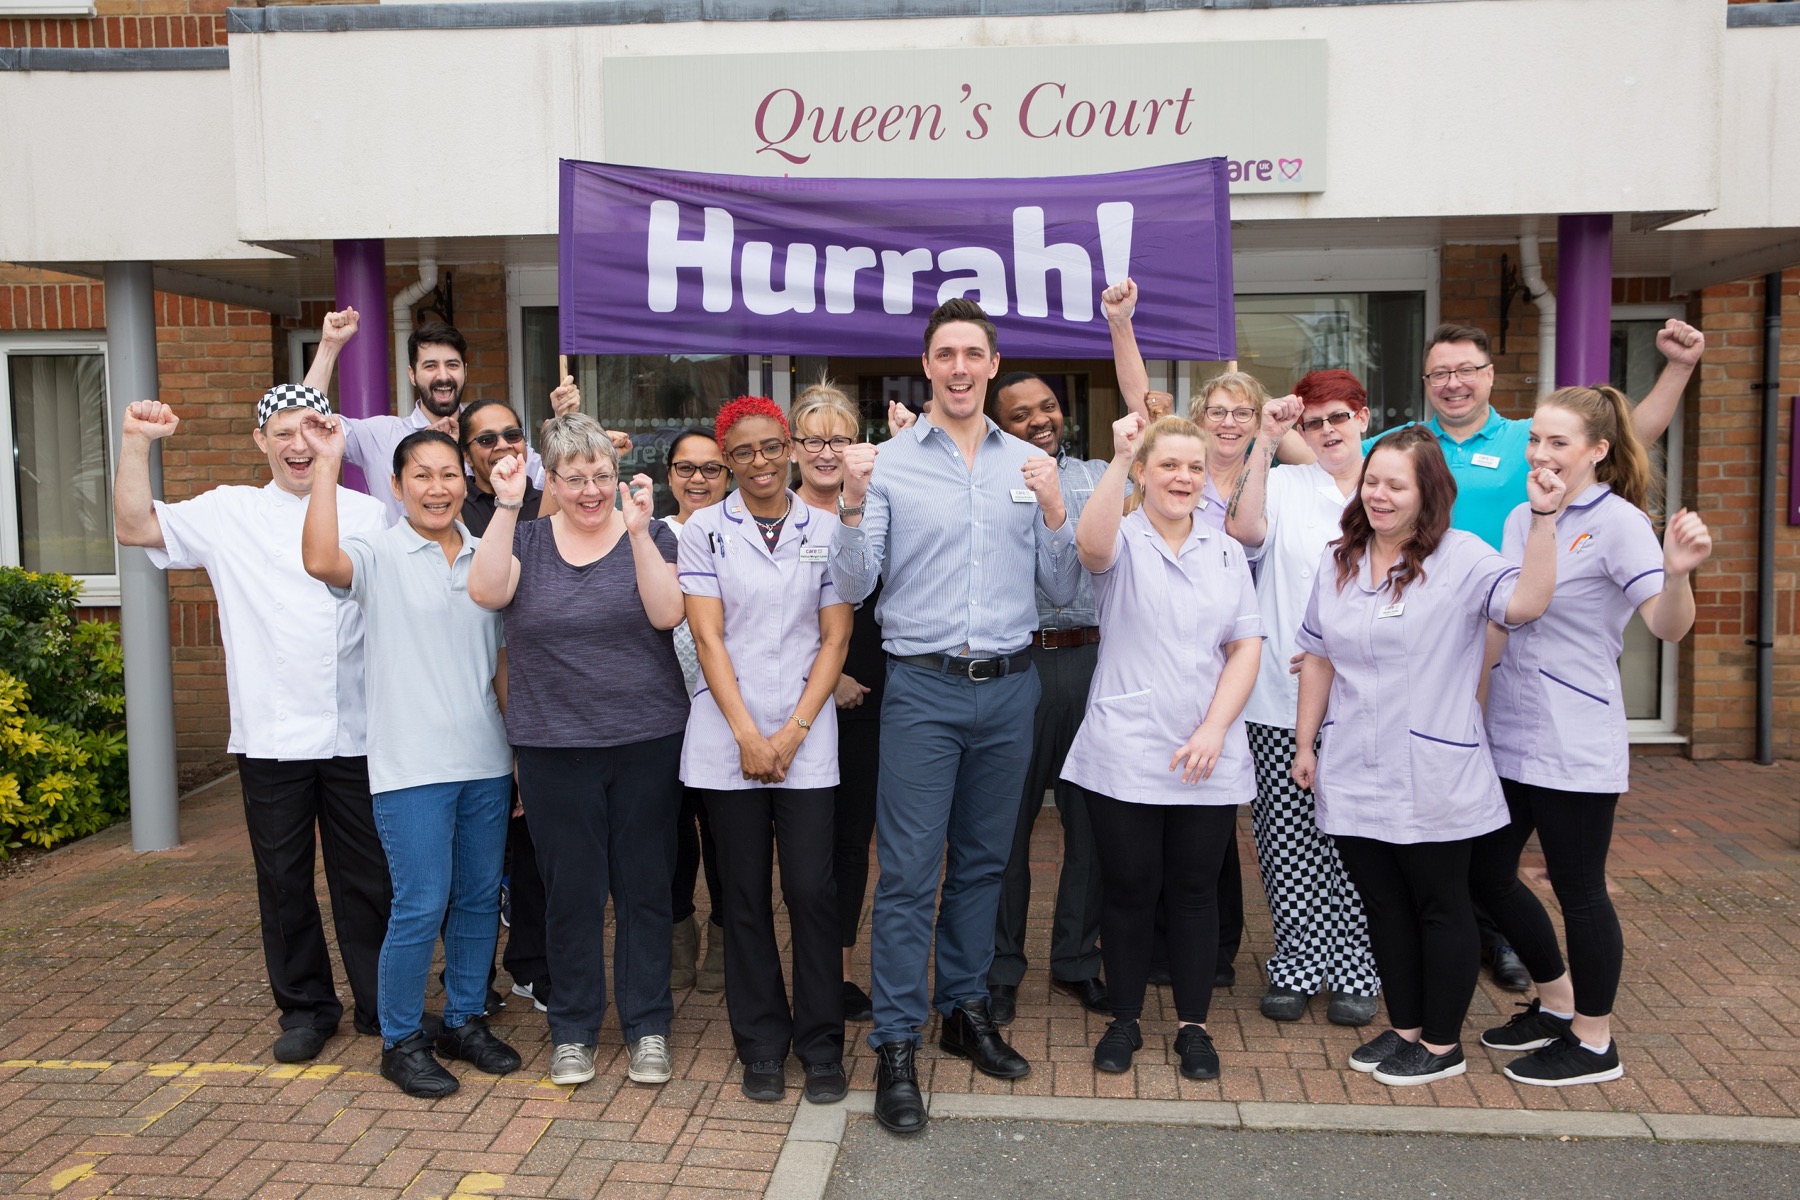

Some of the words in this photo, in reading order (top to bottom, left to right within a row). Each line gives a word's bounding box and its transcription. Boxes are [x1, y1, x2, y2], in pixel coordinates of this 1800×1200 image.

[755, 83, 992, 165] Queen's
[1018, 82, 1195, 138] Court
[739, 179, 779, 193] care
[784, 173, 838, 192] home
[1227, 160, 1273, 182] are
[647, 200, 1136, 323] Hurrah!
